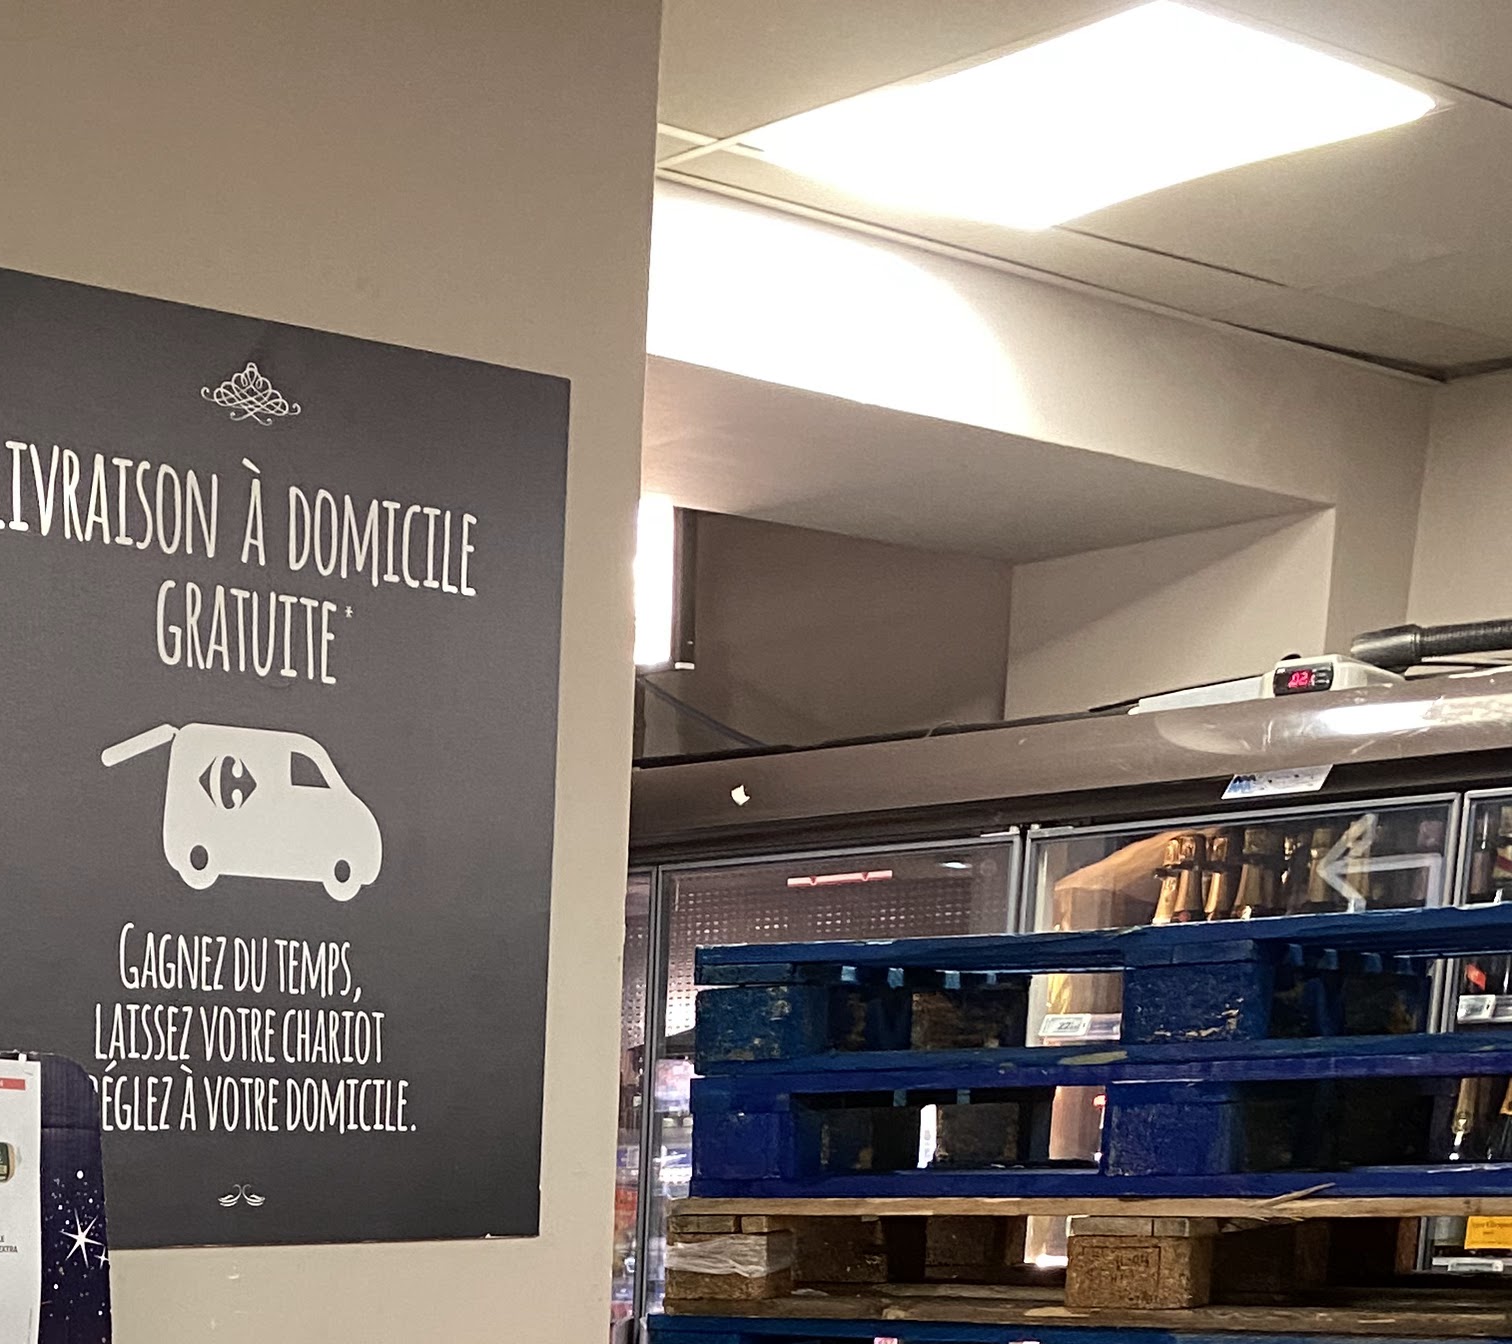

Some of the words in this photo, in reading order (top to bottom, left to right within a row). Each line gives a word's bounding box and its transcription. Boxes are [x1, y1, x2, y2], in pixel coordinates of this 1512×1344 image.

[242, 456, 265, 566] À
[289, 485, 477, 597] DOMICILE
[119, 923, 225, 994] GAGNEZ
[235, 936, 269, 995] DU
[276, 938, 361, 1004] TEMPS,
[95, 1002, 193, 1062] LAISSEZ
[200, 1008, 275, 1064] VOTRE
[283, 1009, 384, 1065] CHARIOT
[179, 1065, 196, 1133] À
[204, 1075, 279, 1133] VOTRE
[286, 1078, 416, 1134] DOMICILE.
